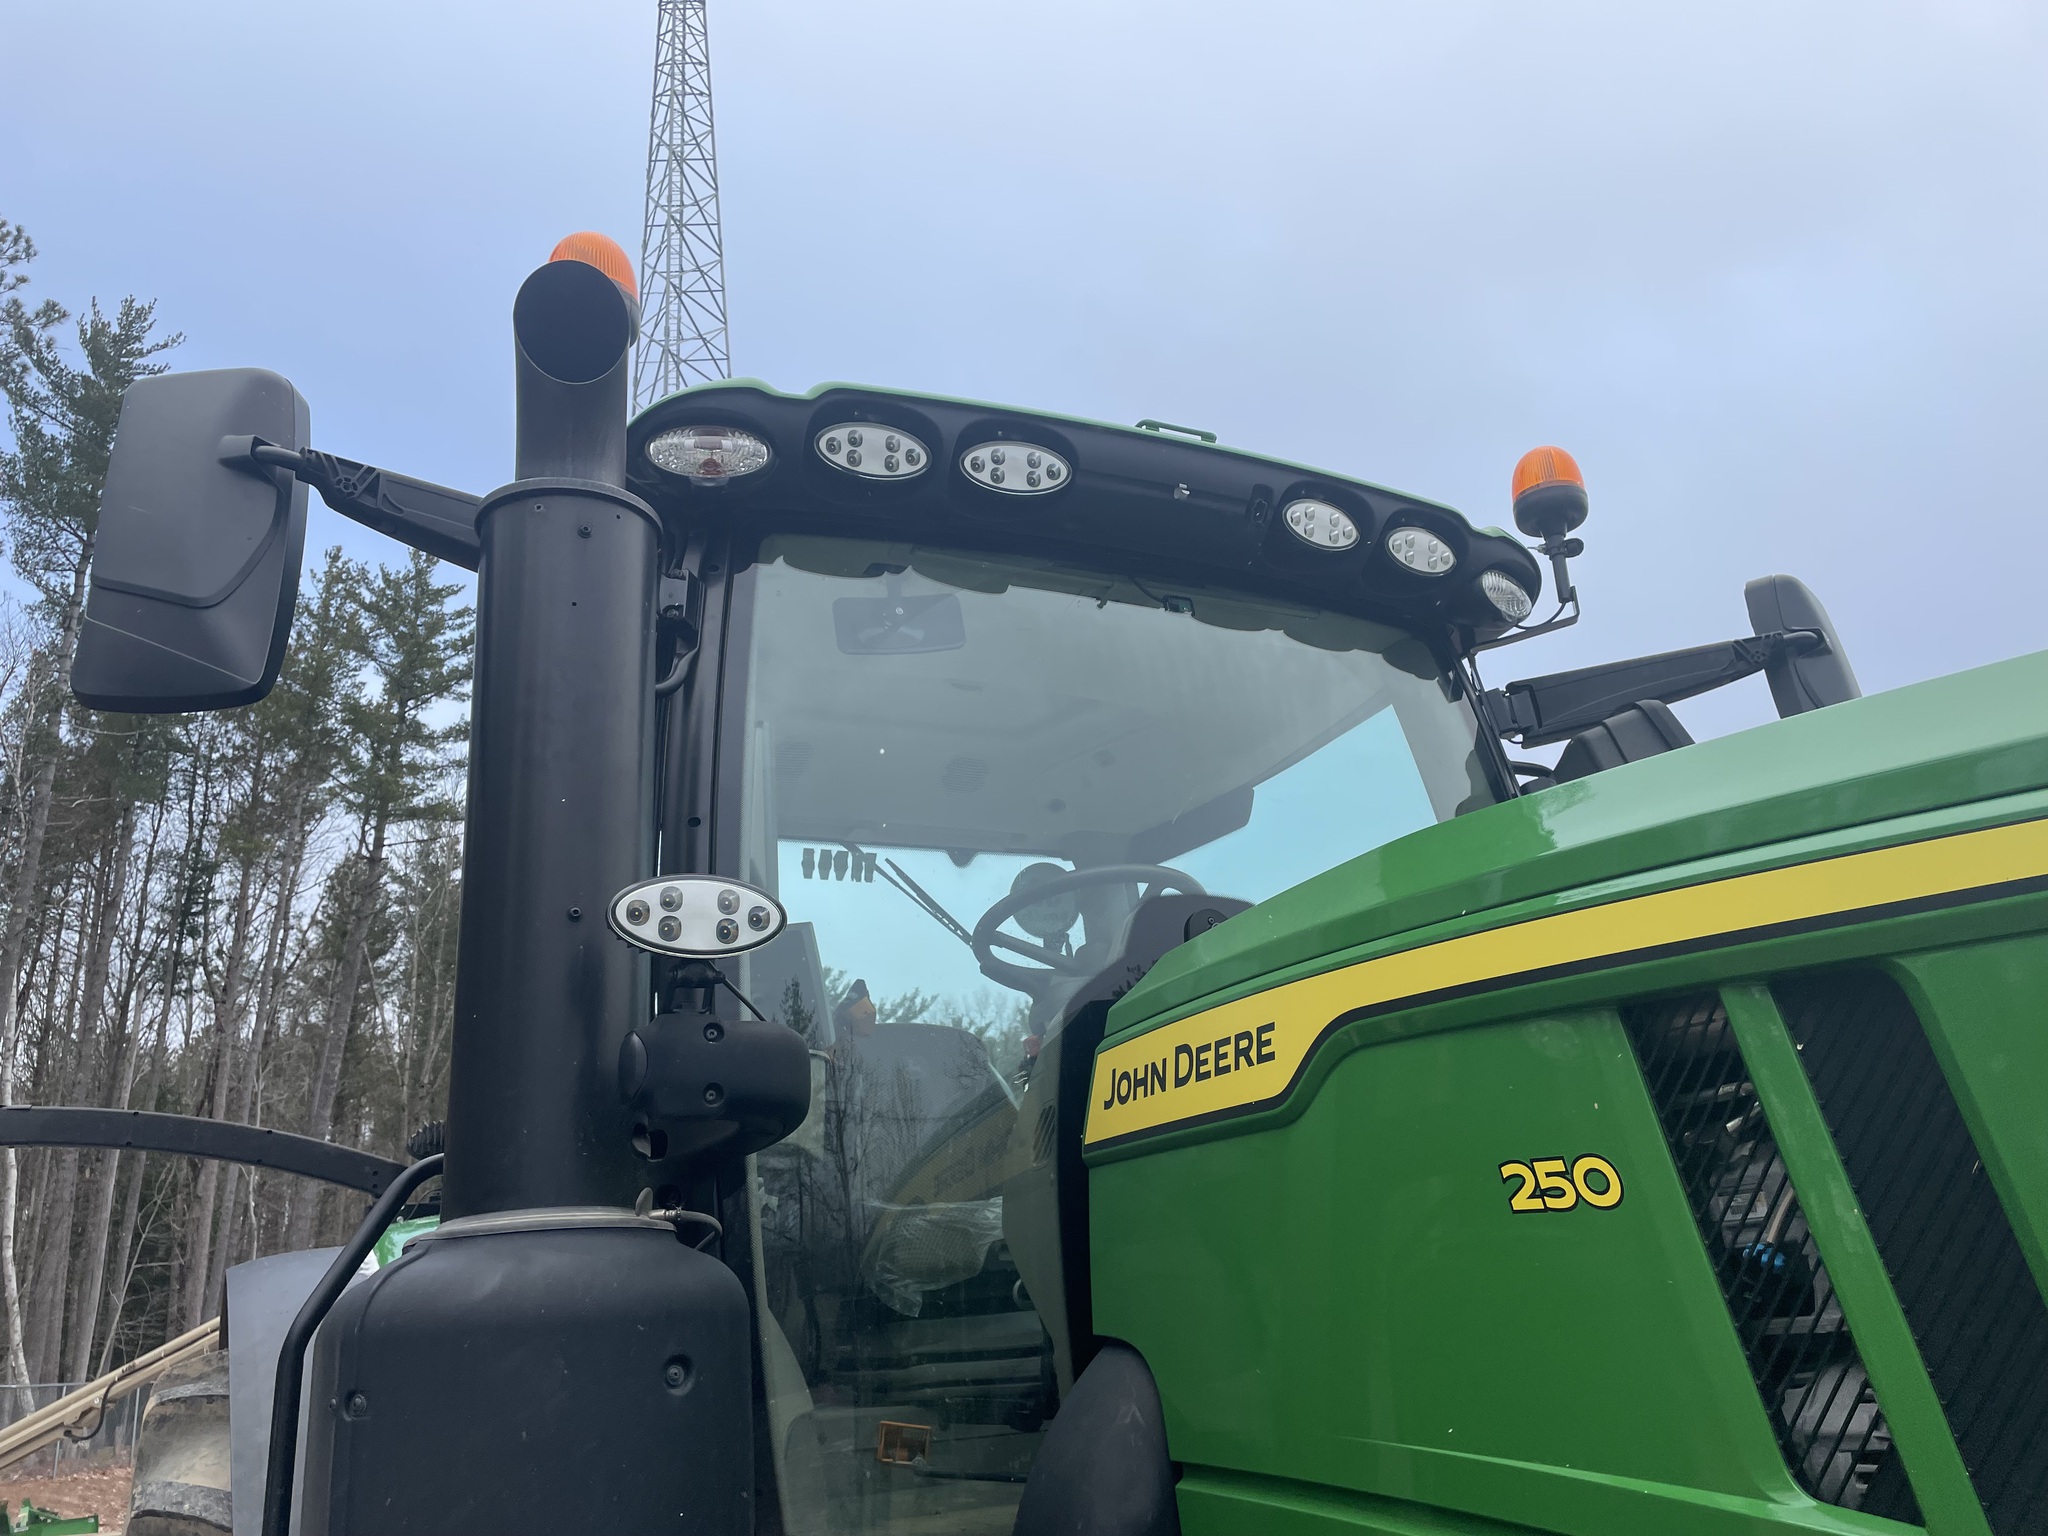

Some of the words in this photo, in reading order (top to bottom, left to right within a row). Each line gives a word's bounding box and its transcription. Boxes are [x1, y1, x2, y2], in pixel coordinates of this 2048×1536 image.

[1103, 1057, 1167, 1111] JOHN
[1173, 1021, 1276, 1089] DEERE
[1498, 1153, 1624, 1214] 250
